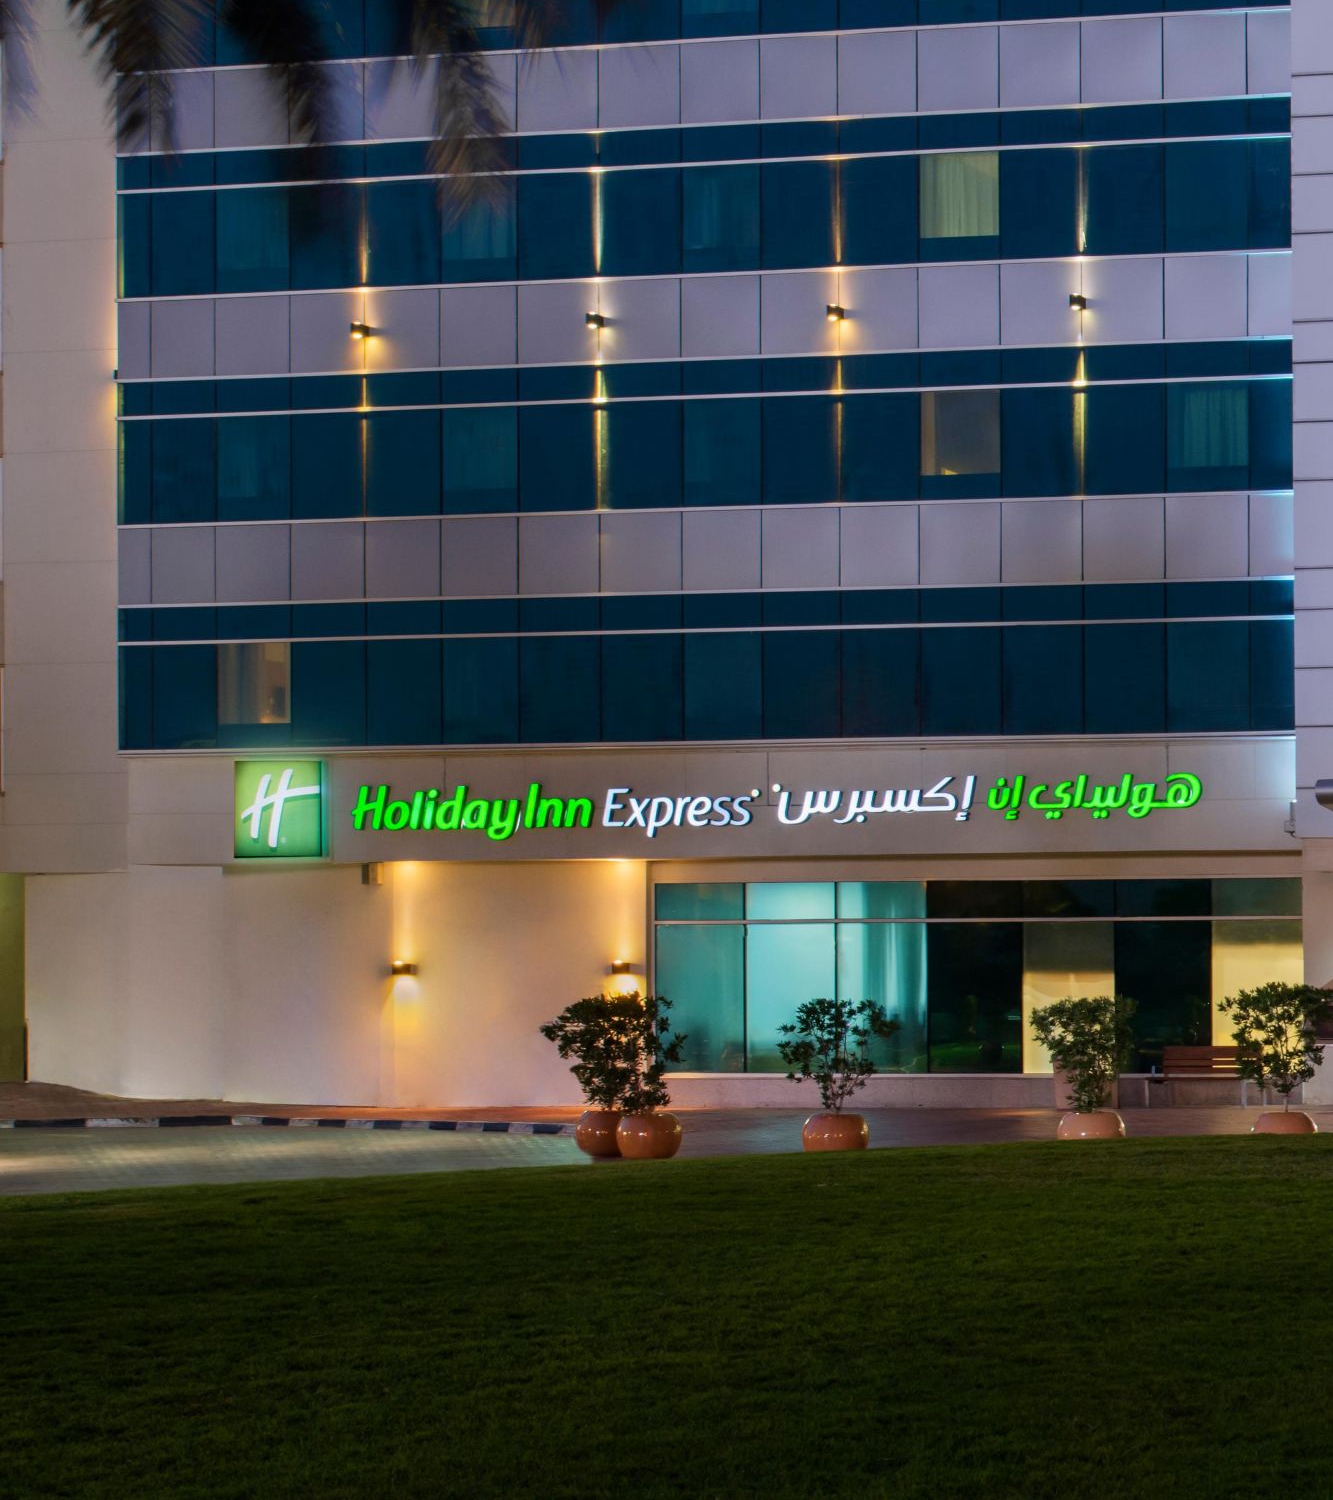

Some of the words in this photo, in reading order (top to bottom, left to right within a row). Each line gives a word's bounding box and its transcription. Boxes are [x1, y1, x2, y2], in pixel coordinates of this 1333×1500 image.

[352, 784, 518, 840] Holiday
[523, 782, 593, 828] Inn
[602, 788, 752, 838] Express
[776, 774, 977, 825] إكسبرس
[986, 775, 1025, 821] إن
[1027, 772, 1203, 819] هوليداي
